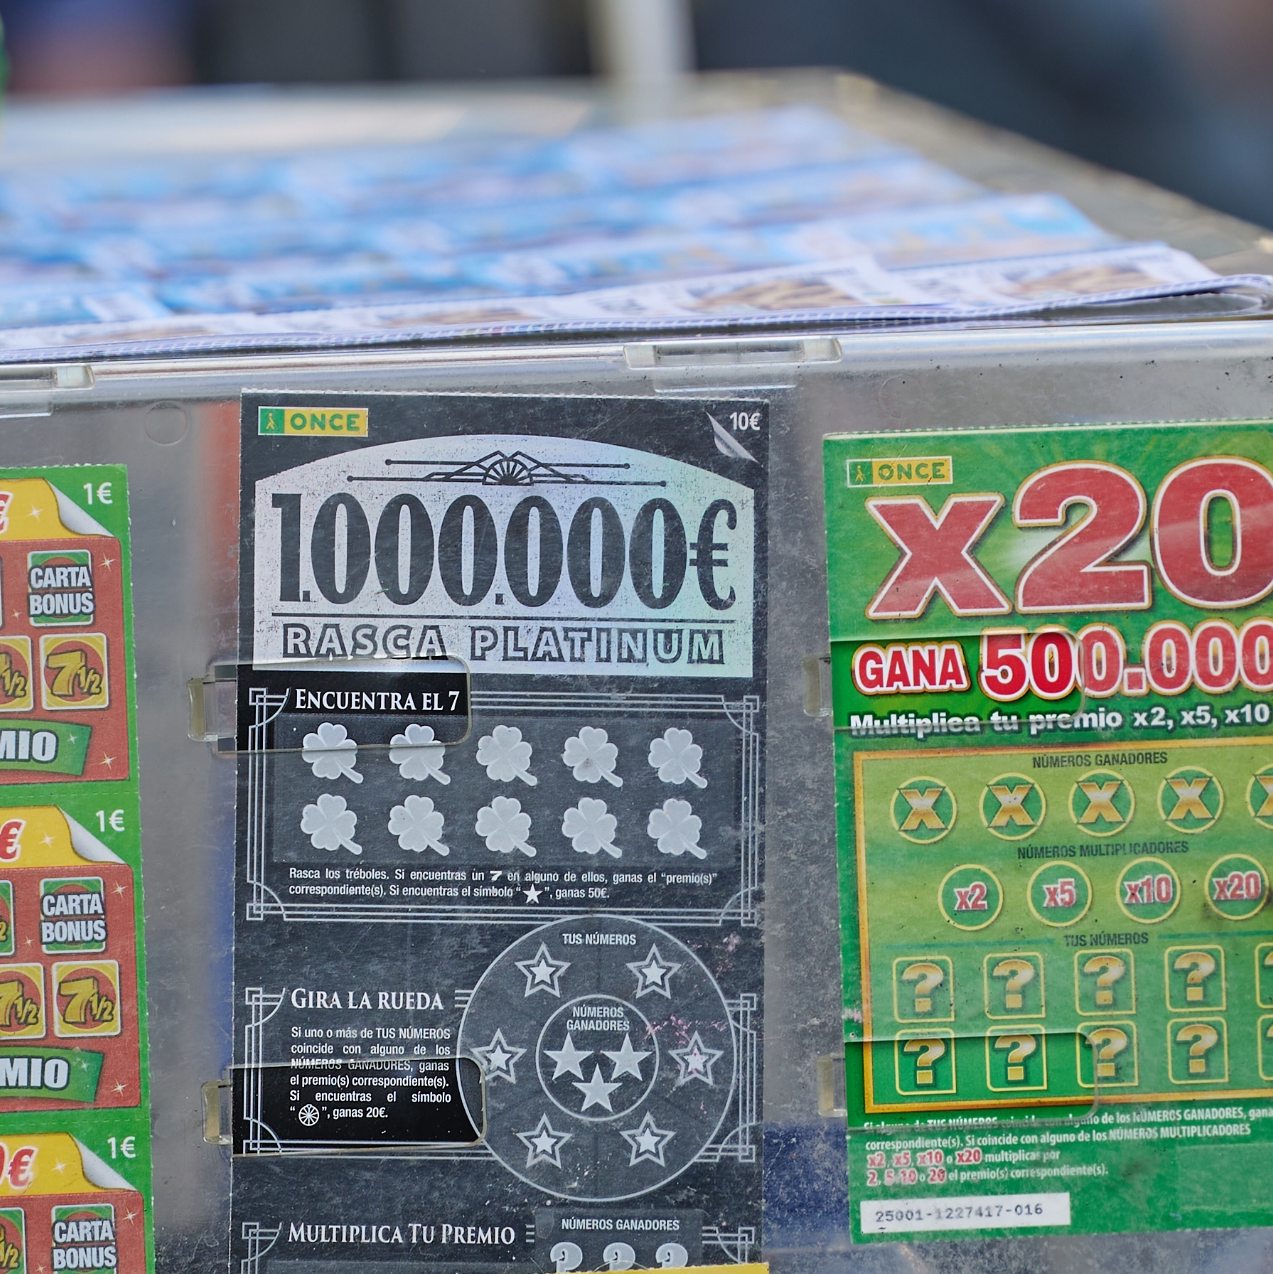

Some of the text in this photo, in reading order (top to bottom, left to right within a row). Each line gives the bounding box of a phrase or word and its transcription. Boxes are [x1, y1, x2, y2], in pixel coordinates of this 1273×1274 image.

[290, 413, 360, 431] ONCE
[729, 412, 761, 431] 10€
[878, 461, 946, 481] ONCE
[83, 482, 114, 504] 1€
[29, 565, 91, 589] CARTA
[29, 593, 94, 617] BONUS
[283, 623, 726, 664] RASCA PLATINUM
[854, 644, 967, 693] GANA
[295, 688, 460, 711] ENCUENTRA EL 7
[850, 713, 982, 741] Multiplica
[991, 711, 1019, 730] tu
[1030, 708, 1122, 735] premio
[1133, 709, 1174, 732] x2,
[1180, 707, 1217, 729] x5,
[1226, 703, 1268, 724] x10
[96, 810, 125, 832] 1€
[953, 871, 1261, 910] x2 x5 x10 x20
[562, 932, 636, 946] TUS NÚMEROS
[1064, 931, 1149, 947] TUS NÚMEROS
[290, 988, 343, 1009] GIRA
[572, 1005, 624, 1018] NÚMEROS
[566, 1019, 629, 1031] GANADORES
[290, 1076, 300, 1087] el
[303, 1075, 350, 1089] premio(s)
[290, 1090, 451, 1103] Si encuentras el símbolo
[333, 1107, 362, 1120] ganas
[107, 1137, 136, 1159] 1€
[53, 1219, 114, 1243] CARTA
[288, 1223, 402, 1244] MULTIPLICA
[441, 1223, 515, 1246] PREMIO
[562, 1217, 679, 1231] NÚMEROS GANADORES
[52, 1246, 117, 1270] BONUS
